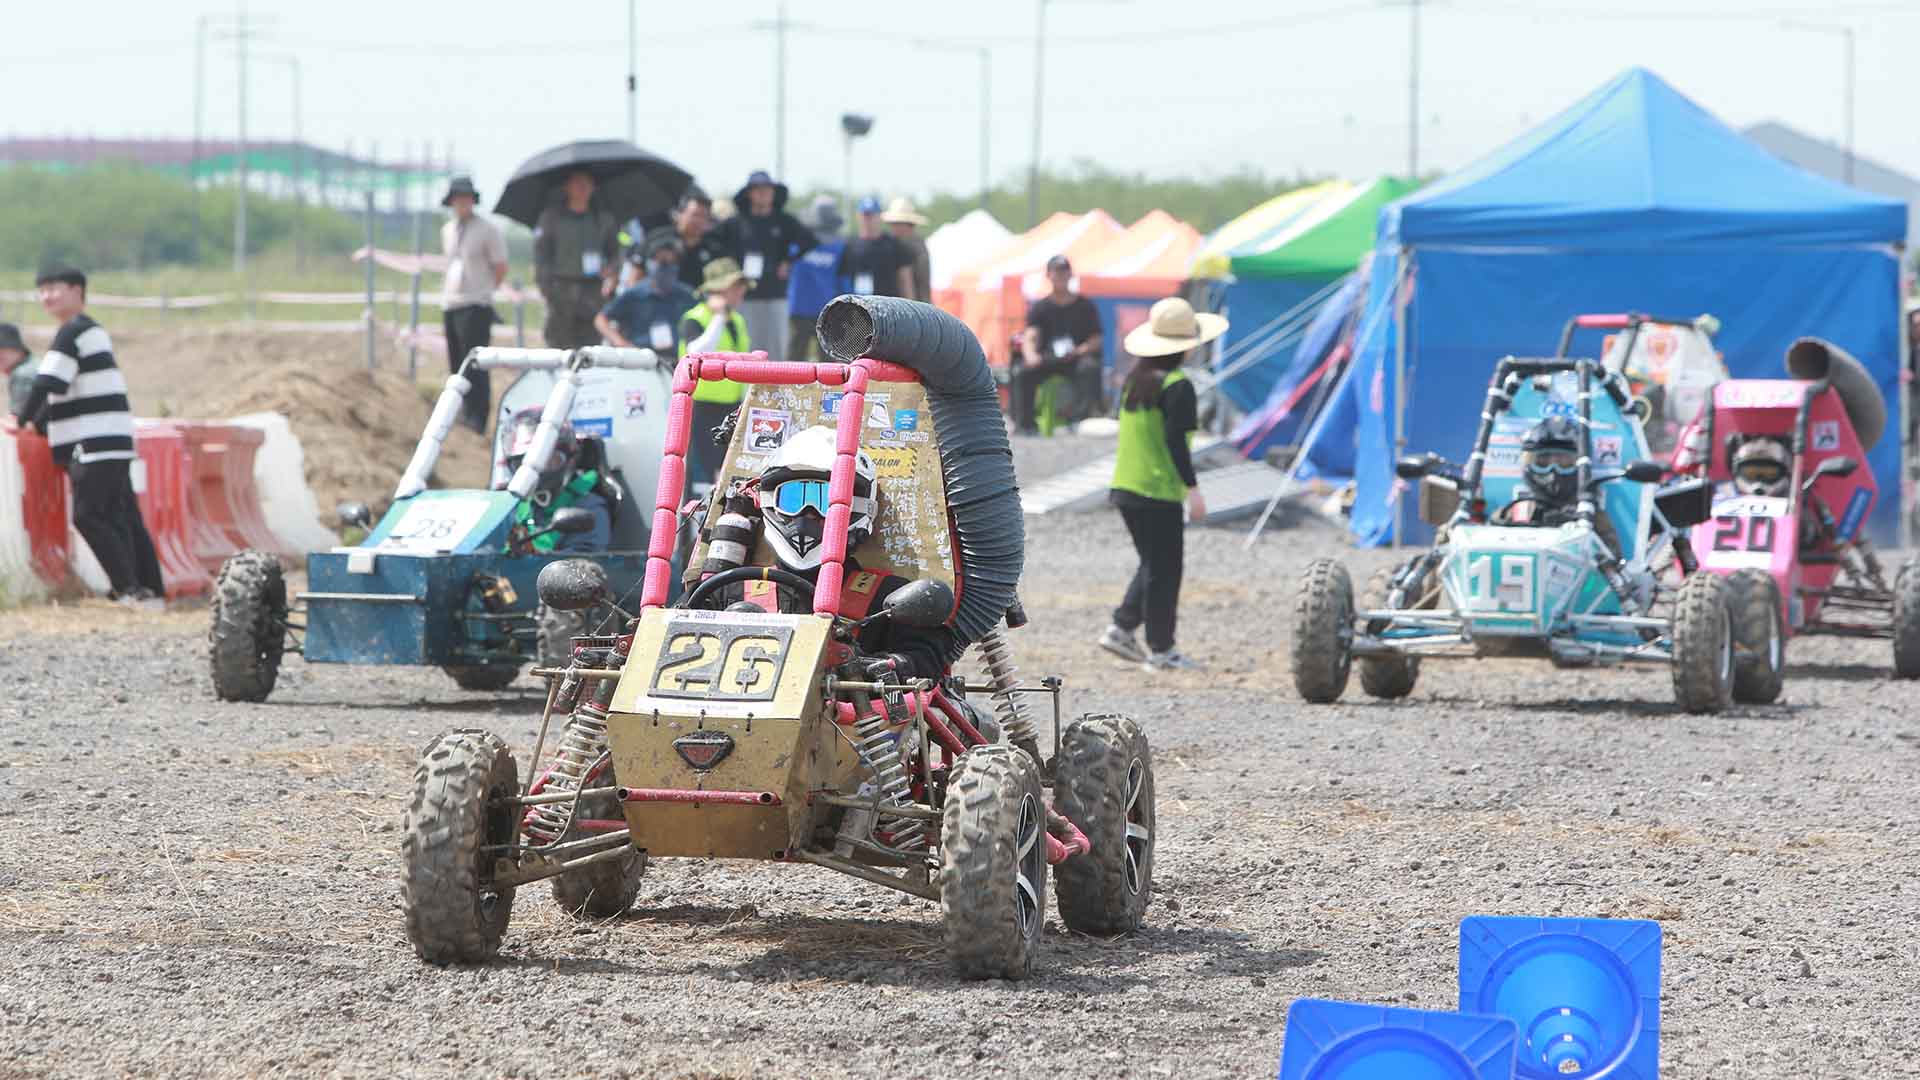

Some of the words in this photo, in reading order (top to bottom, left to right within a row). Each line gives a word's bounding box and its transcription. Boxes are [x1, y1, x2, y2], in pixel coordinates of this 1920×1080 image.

[414, 518, 457, 538] 28
[1712, 516, 1774, 552] 20
[1468, 555, 1534, 612] 19
[656, 632, 781, 694] 26
